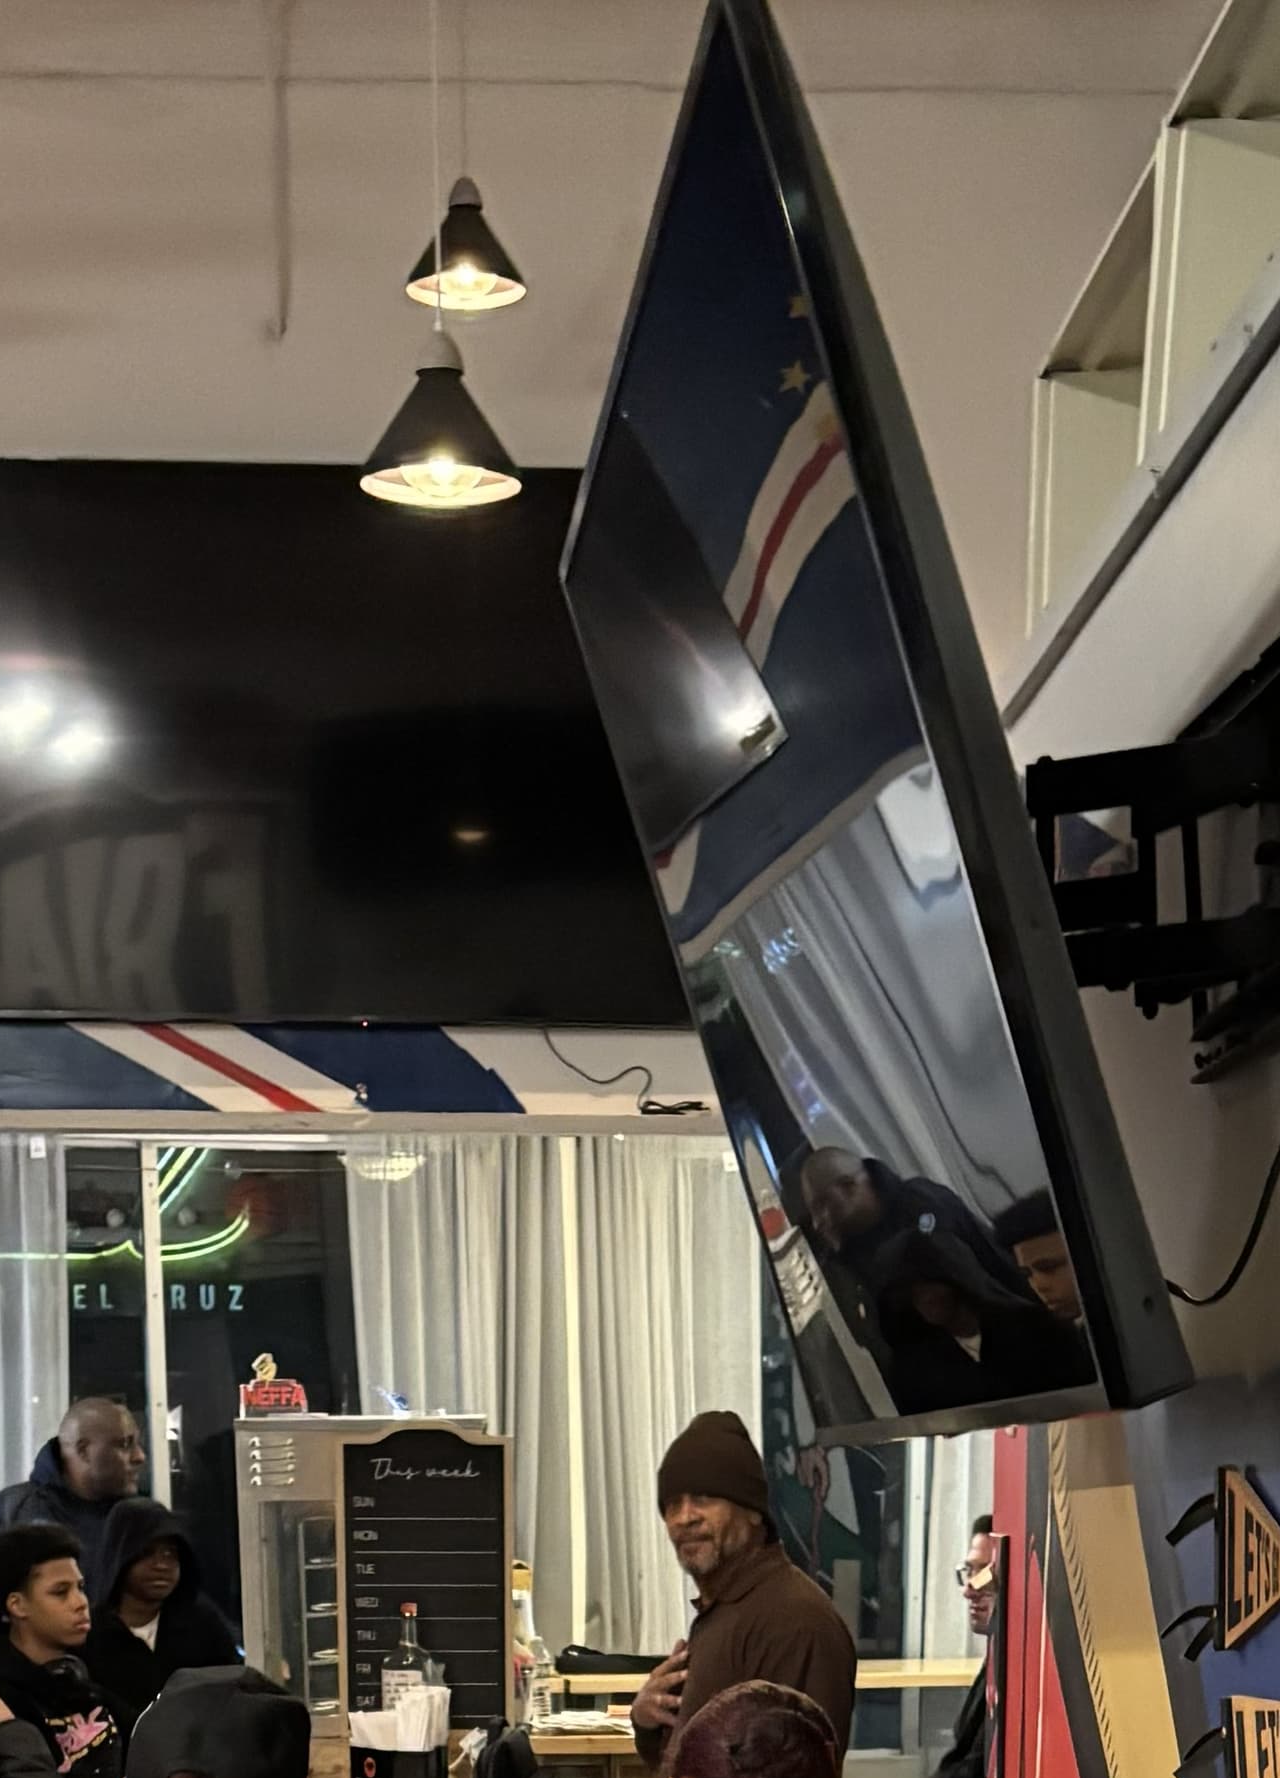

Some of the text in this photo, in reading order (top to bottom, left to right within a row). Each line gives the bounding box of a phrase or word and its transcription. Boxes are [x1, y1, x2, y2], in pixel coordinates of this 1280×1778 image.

[370, 1457, 481, 1480] This week
[352, 1496, 375, 1508] SUN
[1227, 1488, 1271, 1633] LET'S
[355, 1563, 376, 1575] TUE
[356, 1630, 376, 1641] THU
[355, 1663, 371, 1674] FRI
[356, 1695, 376, 1707] SAT
